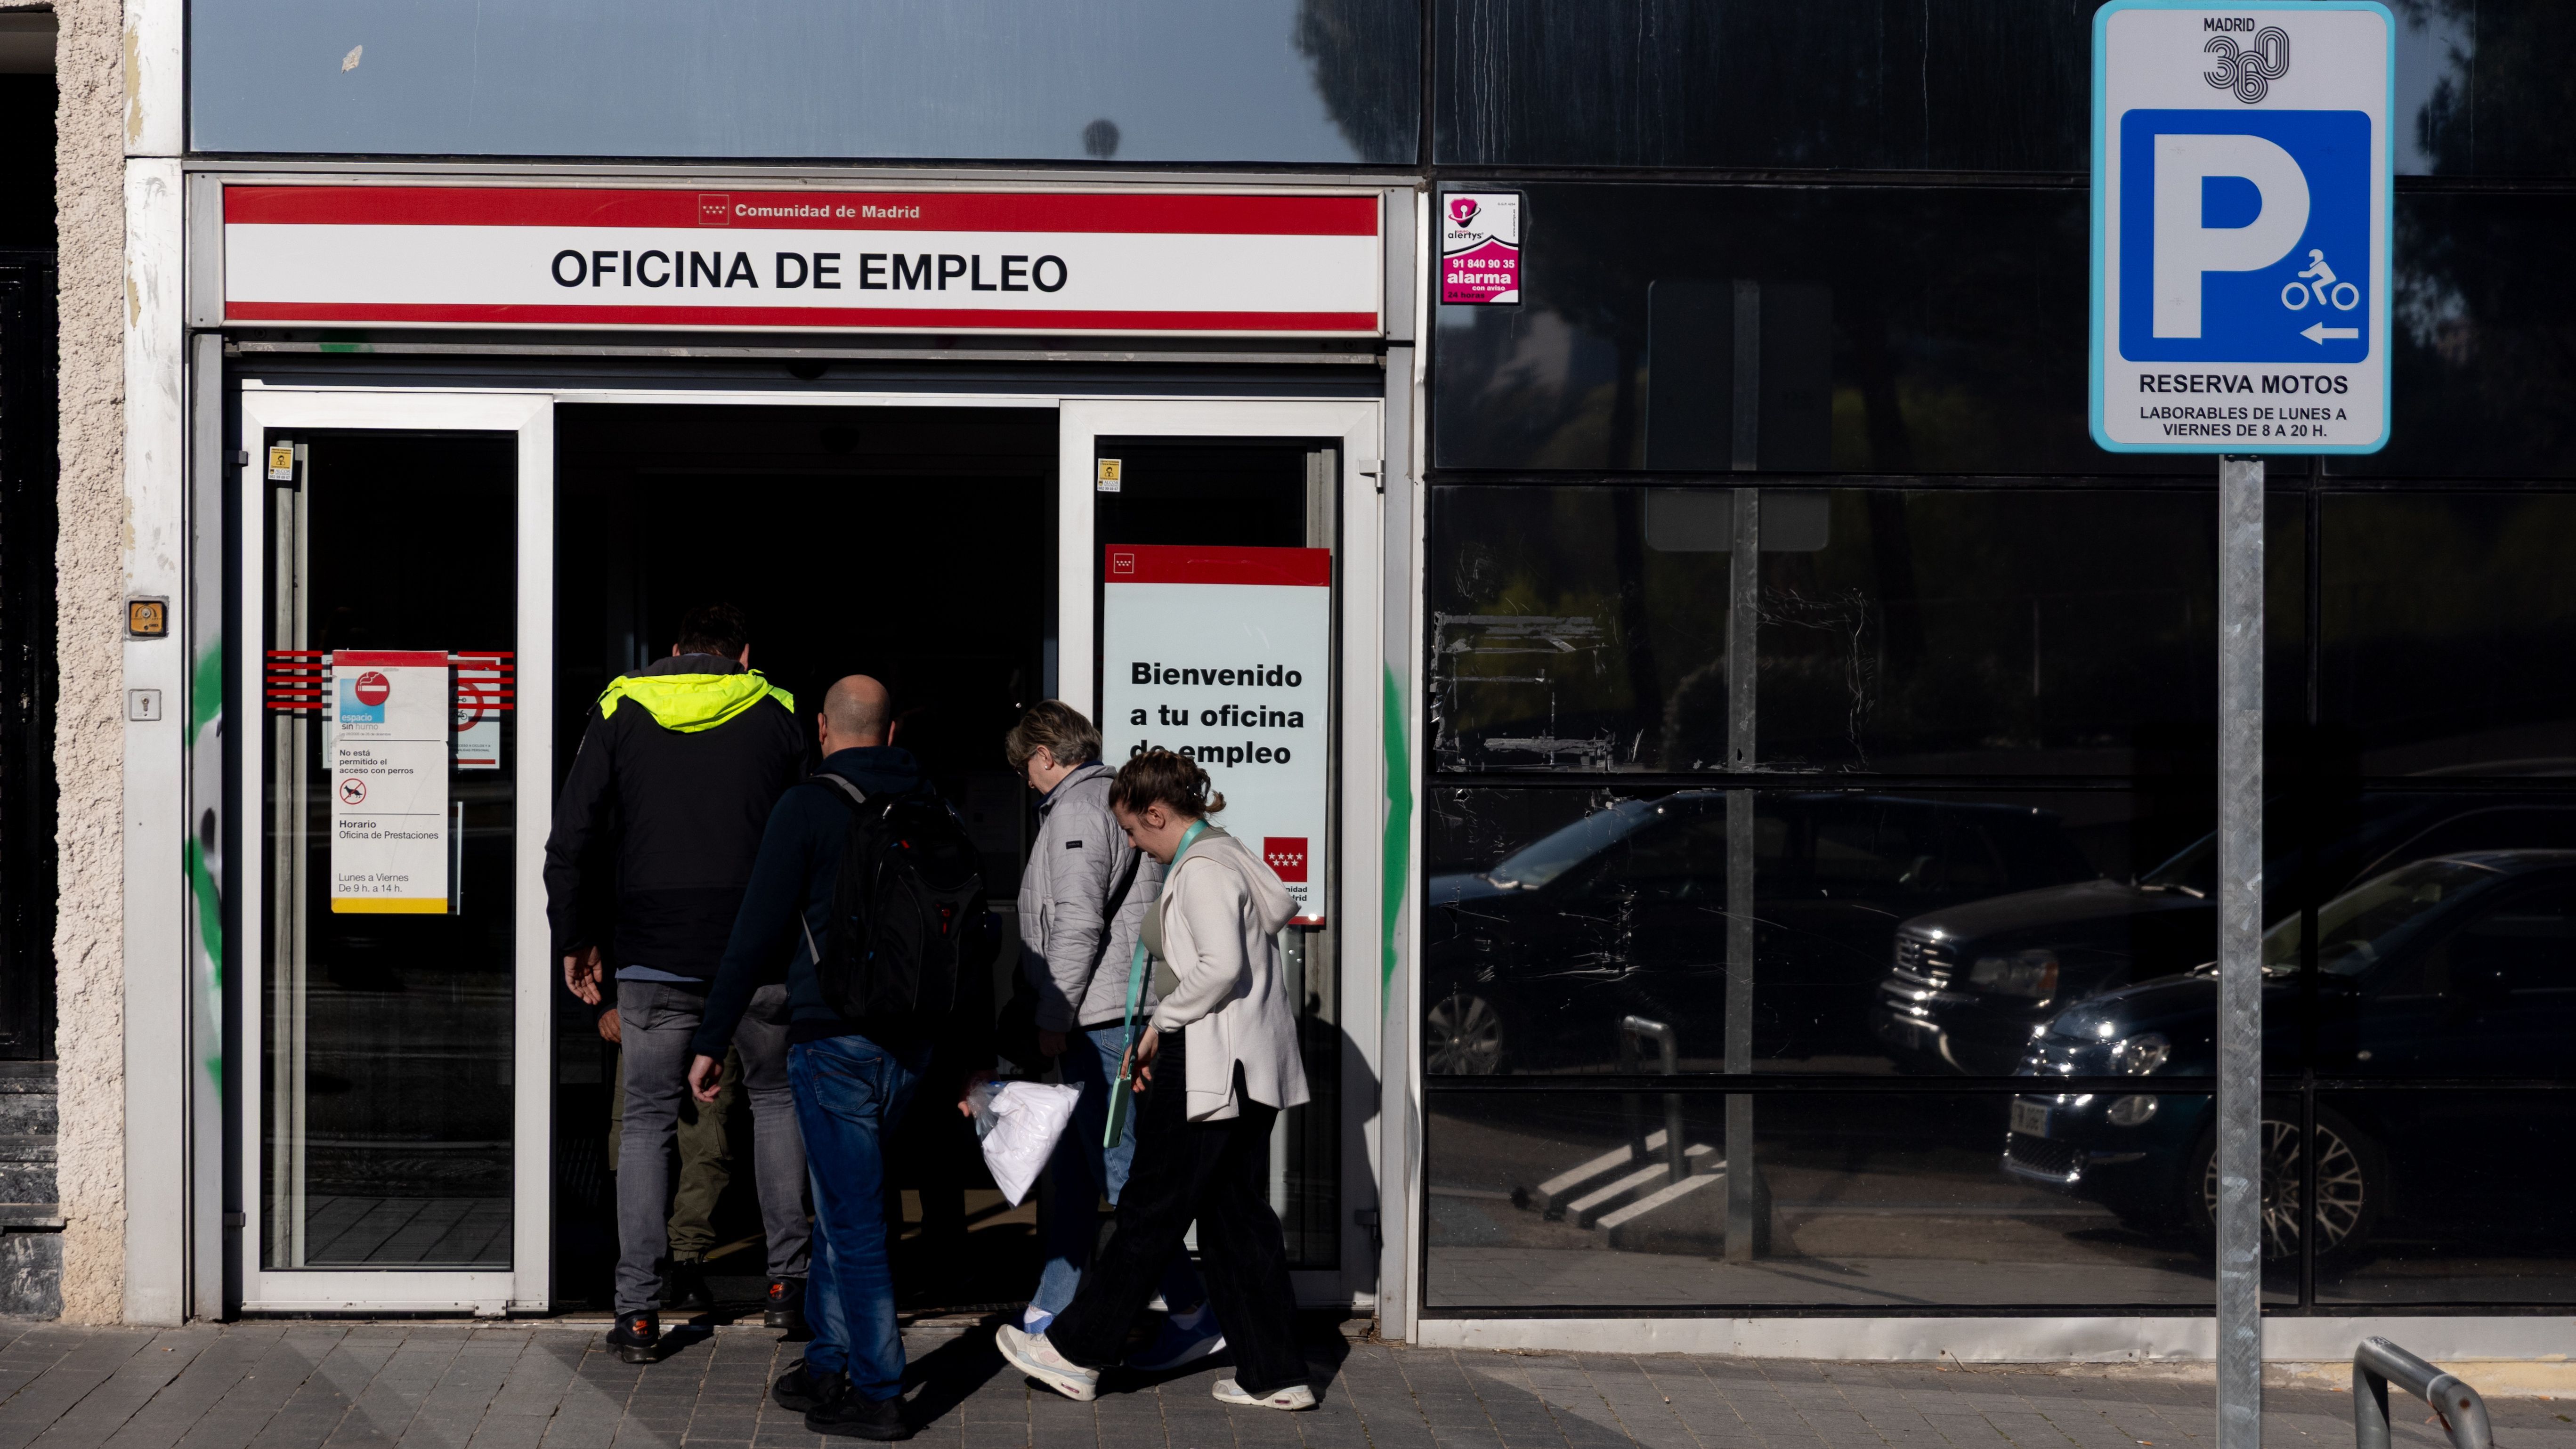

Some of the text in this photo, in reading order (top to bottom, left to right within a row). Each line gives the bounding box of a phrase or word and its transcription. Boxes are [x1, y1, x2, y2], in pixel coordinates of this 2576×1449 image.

[2203, 17, 2255, 32] MADRID
[2203, 26, 2290, 104] 360
[735, 204, 920, 218] Comunidad de Madrid
[2153, 134, 2310, 339] P
[1452, 259, 1515, 268] 91 840 90 35
[551, 250, 1068, 292] OFICINA DE EMPLEO
[1447, 270, 1511, 284] alarma
[2139, 374, 2348, 394] RESERVA MOTOS
[2140, 406, 2347, 420] LABORABLES DE LUNES A
[2163, 423, 2327, 437] VIERNES DE 8 A 20 H.
[1131, 662, 1302, 688] Bienvenido
[342, 713, 372, 722] espacio
[1130, 704, 1304, 728] a tu oficina
[1130, 739, 1166, 759] d
[340, 758, 378, 766] permitido
[340, 820, 376, 828] Horario
[339, 830, 439, 839] Oficina de Prestaciones
[339, 873, 366, 882] Lunes
[376, 873, 409, 882] Viernes
[339, 884, 351, 892] De
[353, 884, 359, 892] 9
[362, 884, 370, 892] h.
[381, 884, 392, 892] 14
[394, 884, 402, 892] h.
